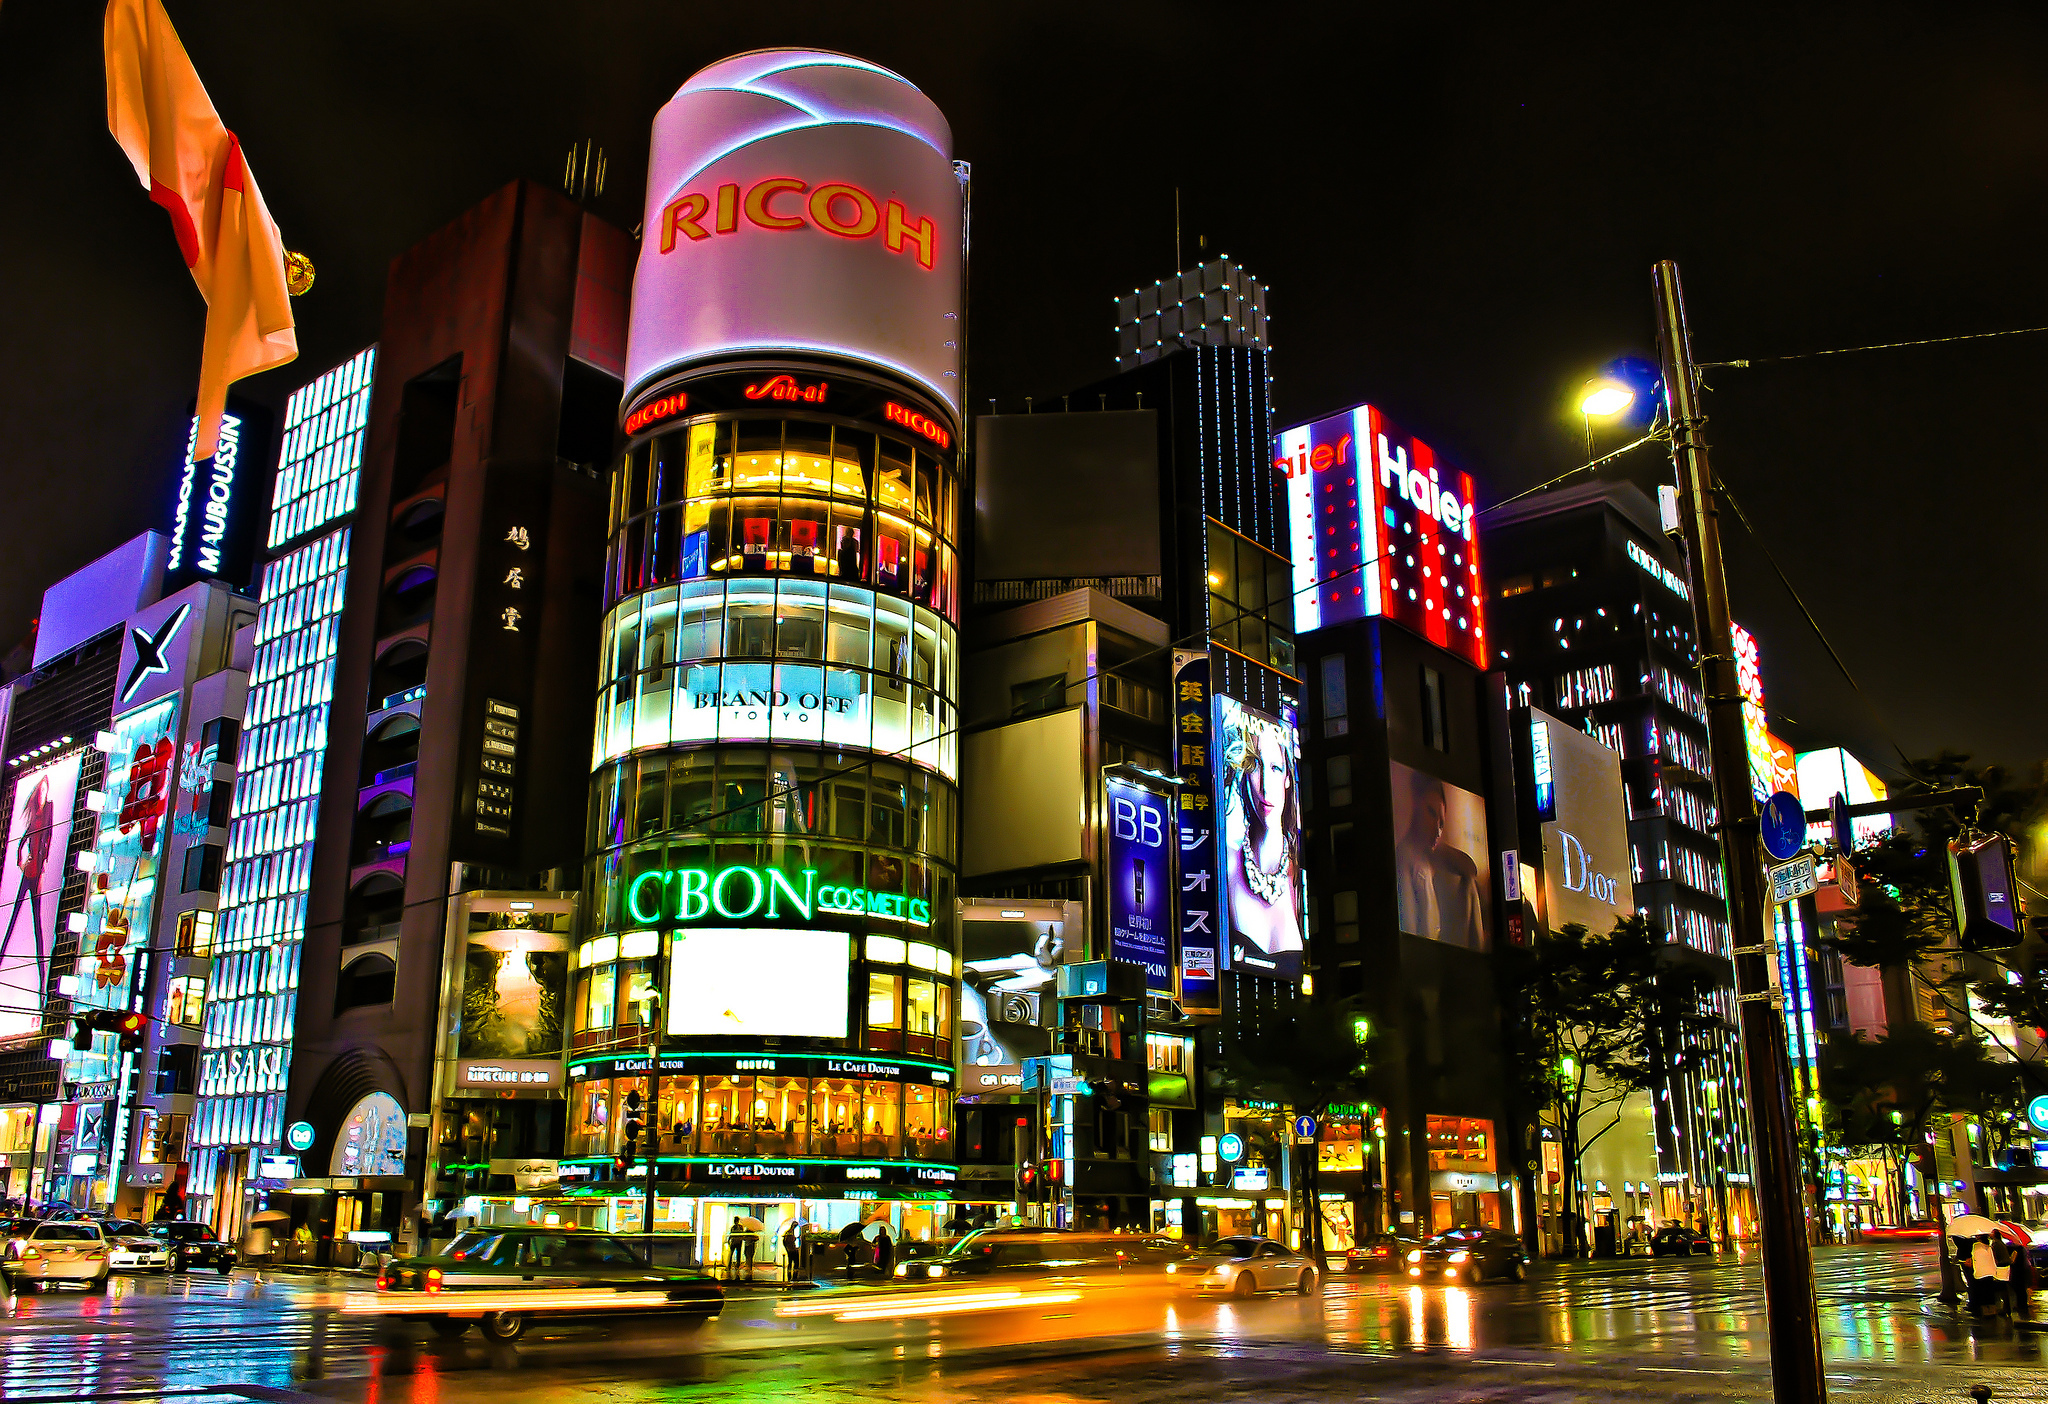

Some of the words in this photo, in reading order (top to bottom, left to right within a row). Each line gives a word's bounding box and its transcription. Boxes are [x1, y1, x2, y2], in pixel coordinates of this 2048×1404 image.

[659, 178, 936, 270] RICOH
[745, 375, 828, 403] San-ai
[625, 392, 687, 435] RICOH
[885, 401, 950, 449] RICOH
[1274, 433, 1352, 479] aier
[197, 413, 242, 573] MAUBOUSSIN
[1377, 432, 1475, 542] Haier
[694, 691, 790, 709] BRAND
[799, 693, 853, 714] OFF
[734, 711, 809, 722] TOYO
[1181, 827, 1212, 933] ジオス
[1557, 828, 1618, 906] Dior
[818, 884, 931, 921] COSMETCS
[1187, 959, 1200, 968] 3F
[202, 1047, 283, 1080] TASAKI
[1001, 1074, 1022, 1086] DIG
